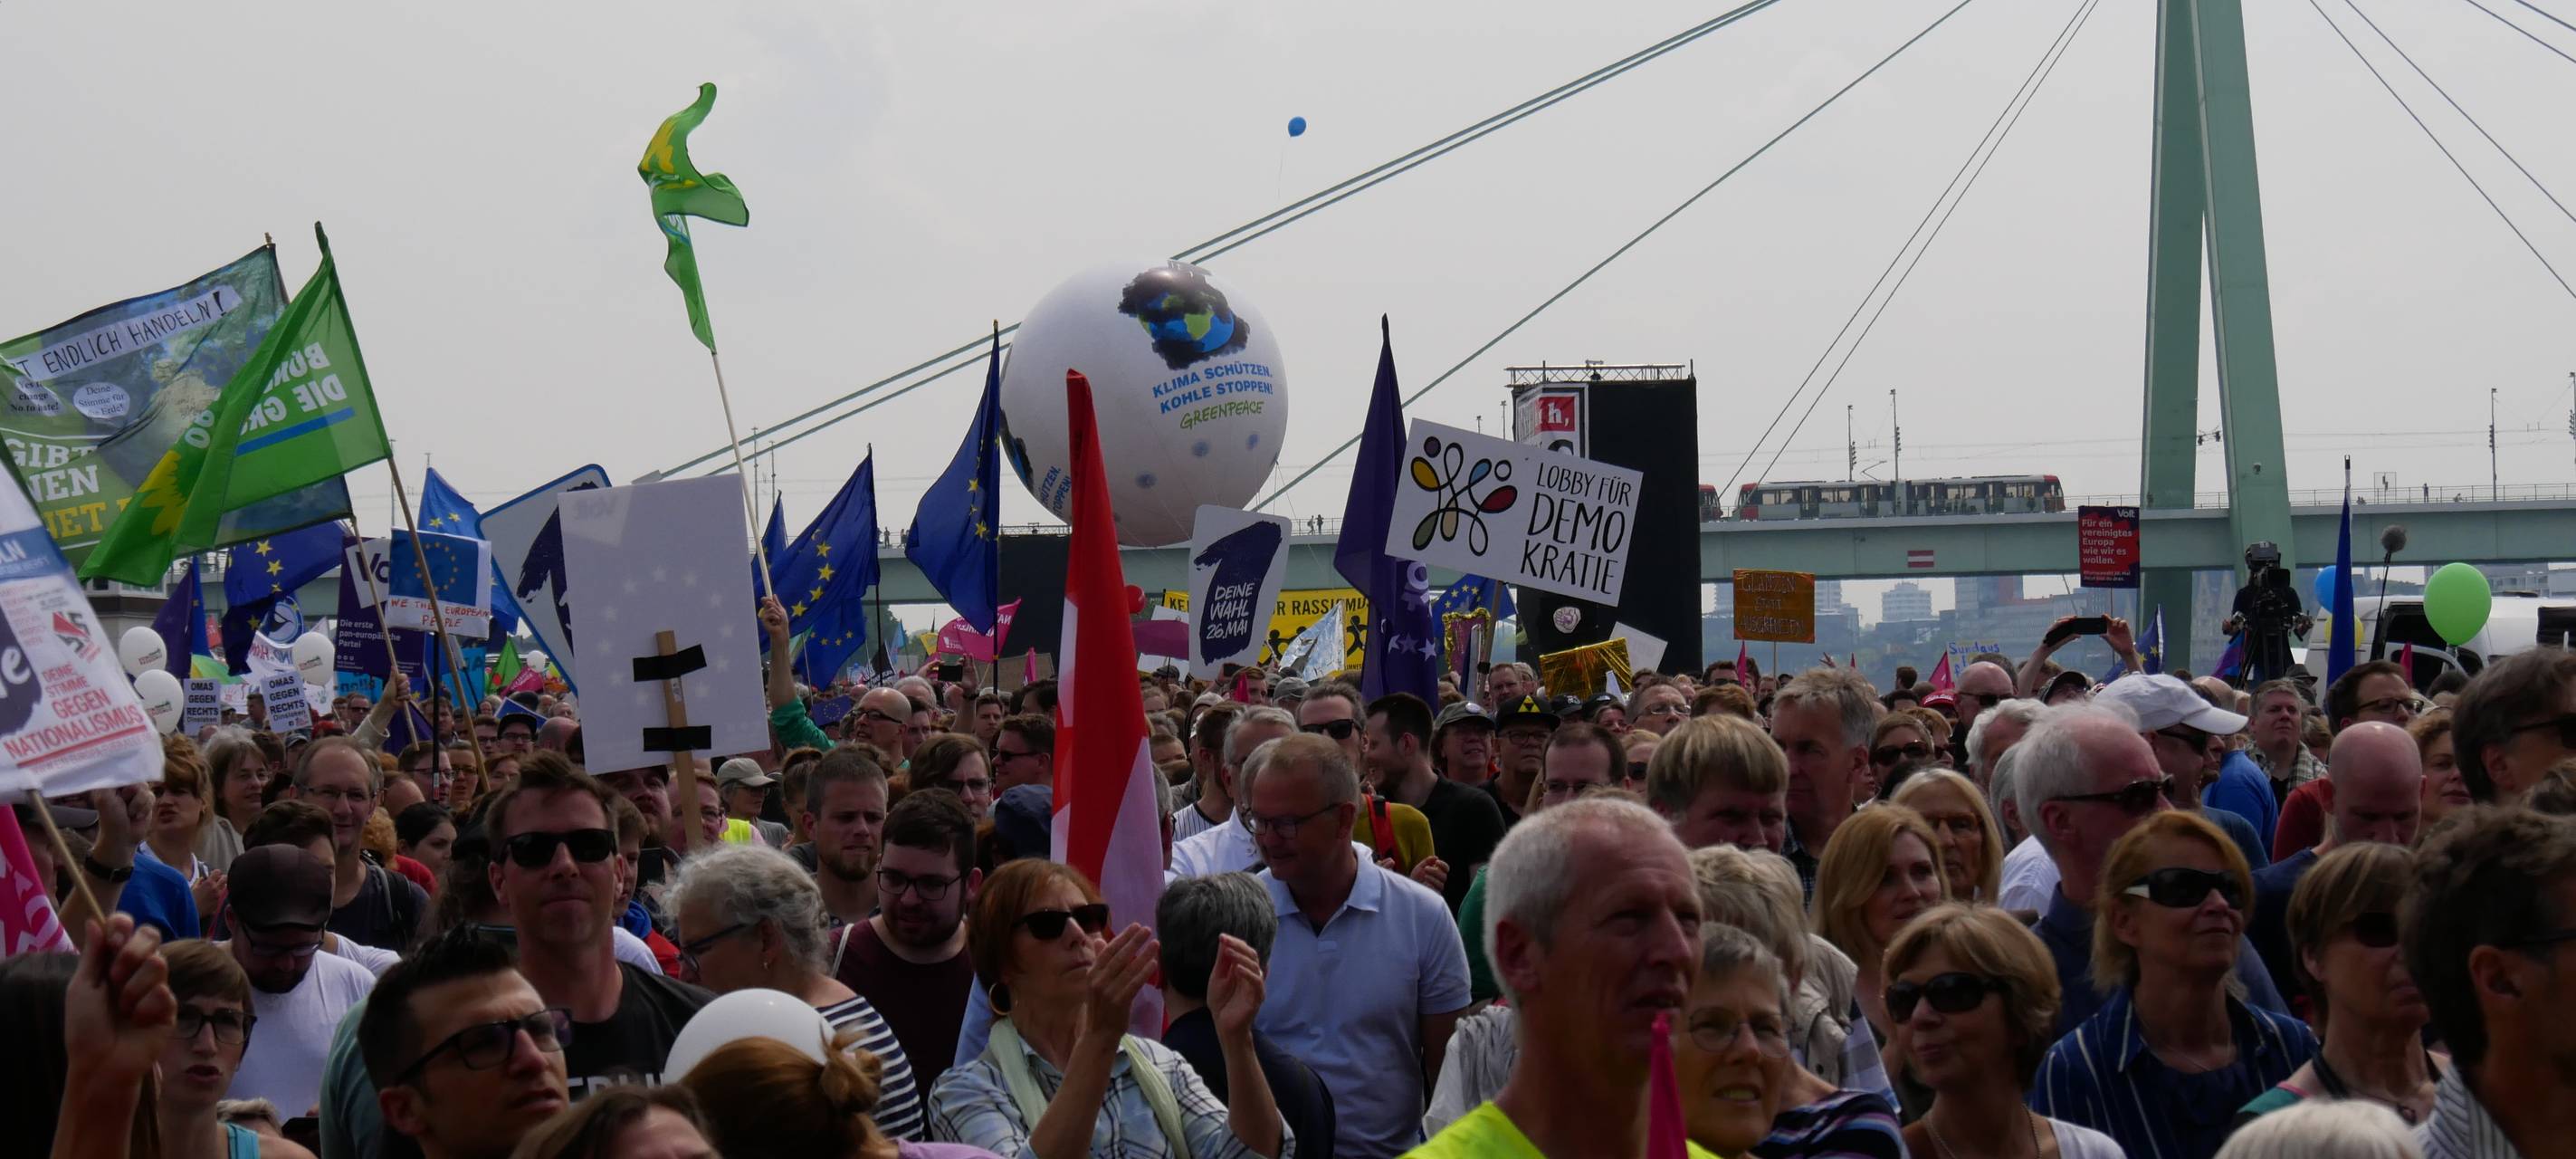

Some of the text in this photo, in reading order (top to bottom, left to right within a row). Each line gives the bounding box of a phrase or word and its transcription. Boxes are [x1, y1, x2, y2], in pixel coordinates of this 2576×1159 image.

[12, 359, 33, 378] T
[43, 329, 122, 374] ENDLICH
[1152, 361, 1273, 398] KLIMA SCHÜTZEN.
[86, 386, 110, 396] Deine
[1160, 380, 1273, 414] KOHLE STOPPEN!
[79, 393, 124, 407] Stimme für
[25, 404, 35, 412] to
[101, 404, 124, 415] Erde!
[1180, 399, 1264, 429] GREENPEACE
[27, 465, 100, 503] EN
[1537, 462, 1631, 507] LOBBY FÜR
[43, 502, 106, 539] ET
[2117, 509, 2135, 518] Volt
[1527, 492, 1626, 553] DEMO
[2082, 519, 2113, 528] Für ein
[2082, 528, 2132, 538] vereinigtes
[2082, 538, 2114, 547] Europa
[0, 540, 26, 563] LN
[2082, 547, 2098, 555] wie
[2100, 547, 2114, 555] wir
[356, 551, 389, 583] Vo
[1520, 539, 1618, 594] KRATIE
[2083, 556, 2114, 564] wollen.
[1215, 582, 1255, 601] DEINE
[391, 599, 493, 617] WE THE EUROPEAN
[1210, 599, 1249, 620] WAHL
[339, 619, 352, 627] Die
[423, 616, 463, 627] PEPLE
[339, 639, 361, 648] Partei
[43, 661, 77, 683] DEINE
[46, 675, 89, 698] STIMME
[191, 682, 214, 691] OMAS
[269, 675, 294, 689] OMAS
[188, 694, 216, 704] GEGEN
[269, 687, 300, 701] GEGEN
[52, 688, 111, 719] GEGEN
[270, 699, 305, 714] RECHTS
[186, 707, 219, 716] RECHTS
[3, 704, 146, 759] NATIONALISMUS
